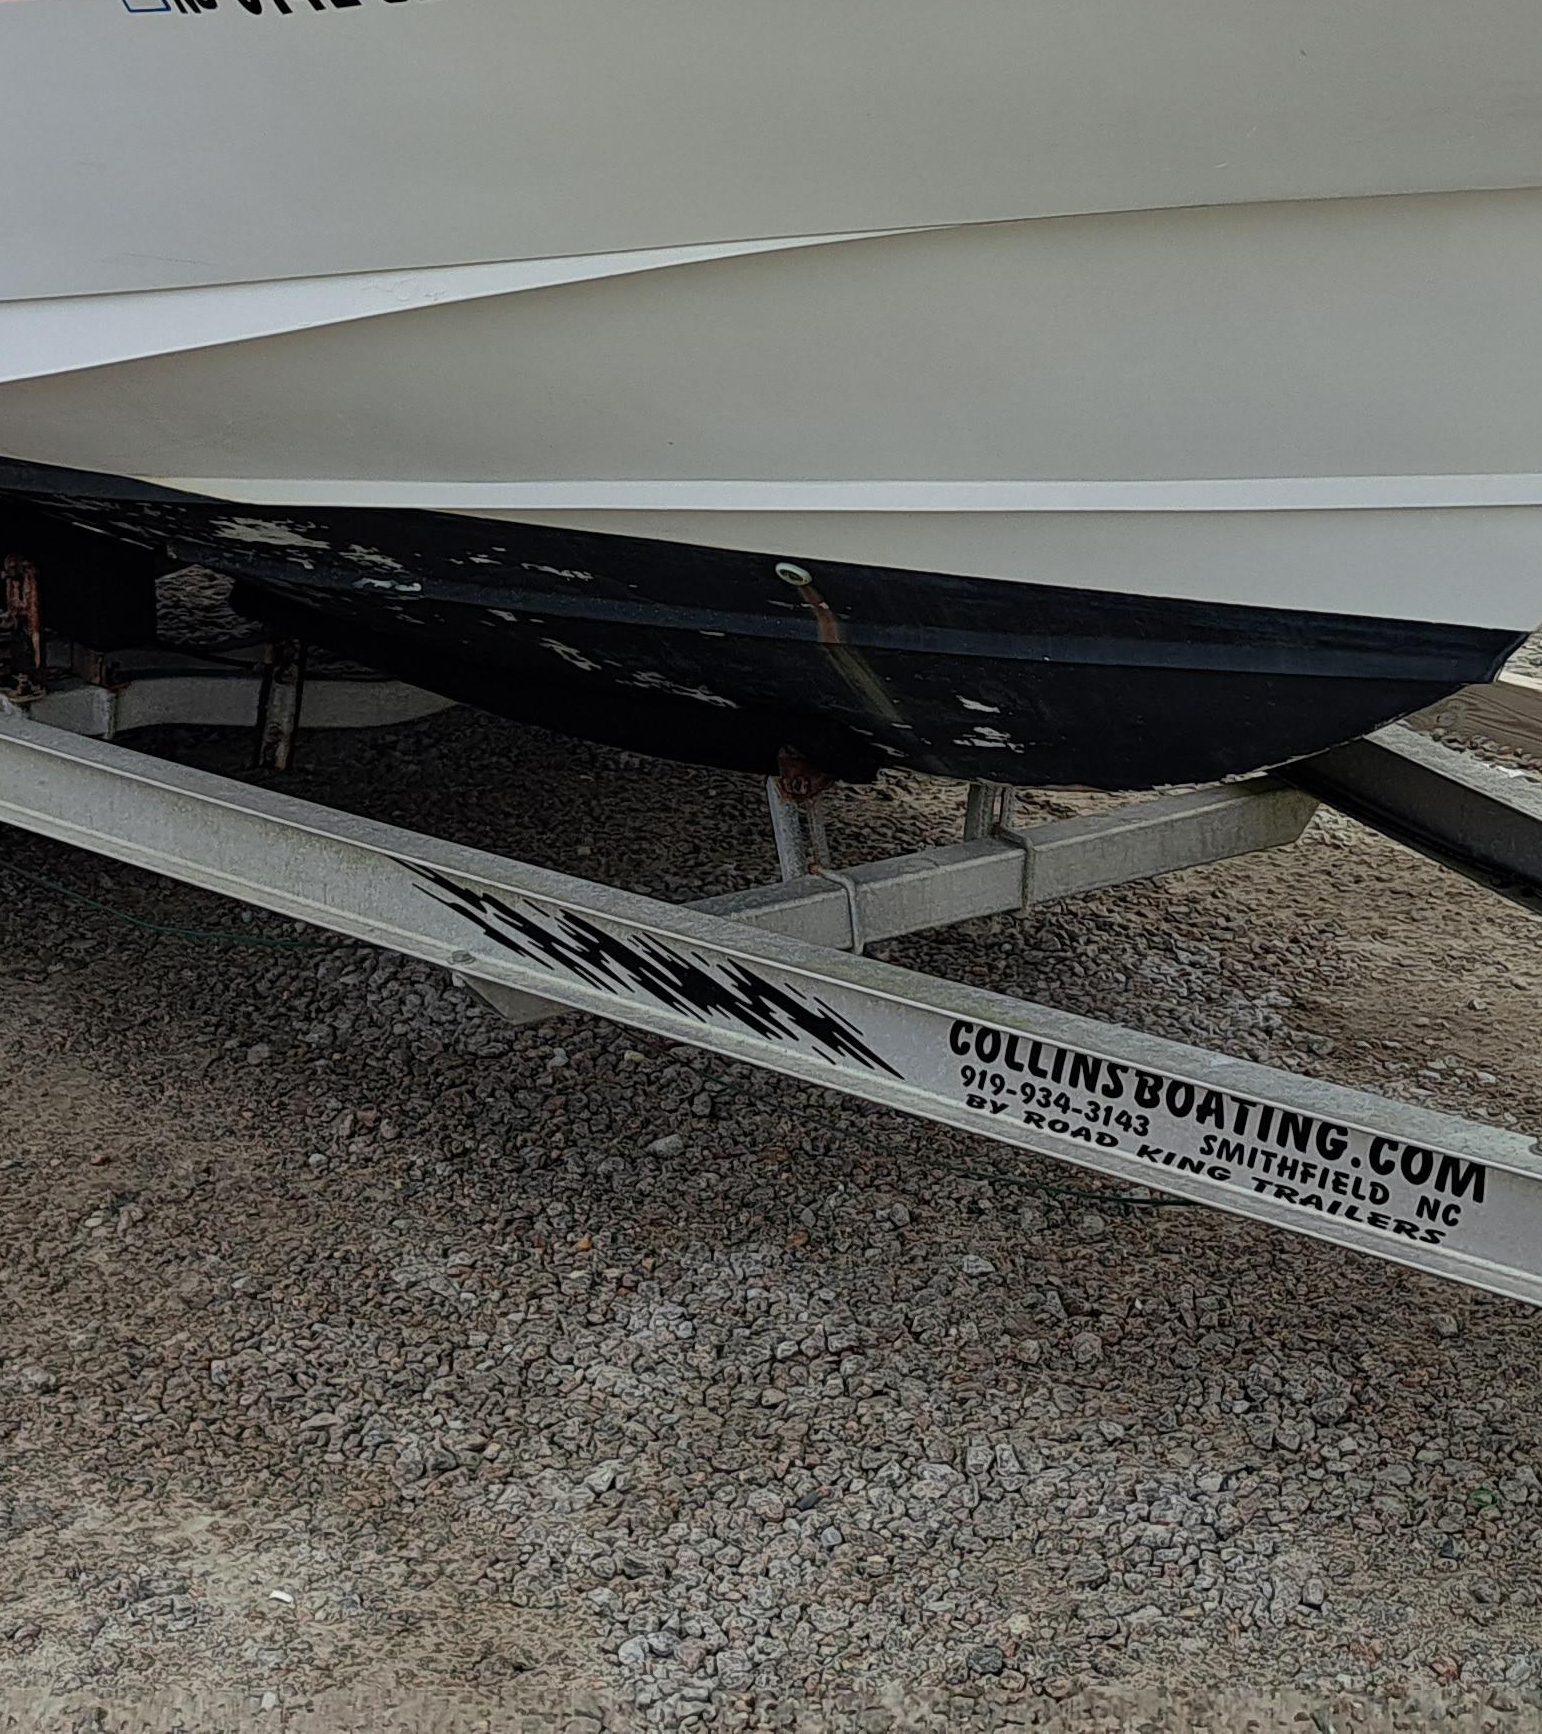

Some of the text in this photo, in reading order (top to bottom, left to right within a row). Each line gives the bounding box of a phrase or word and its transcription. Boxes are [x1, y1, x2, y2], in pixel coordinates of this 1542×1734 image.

[960, 1064, 1461, 1227] 919-934-3143 SMITHFIELD NC
[965, 1093, 1446, 1245] BY ROAD KING TRAILERS
